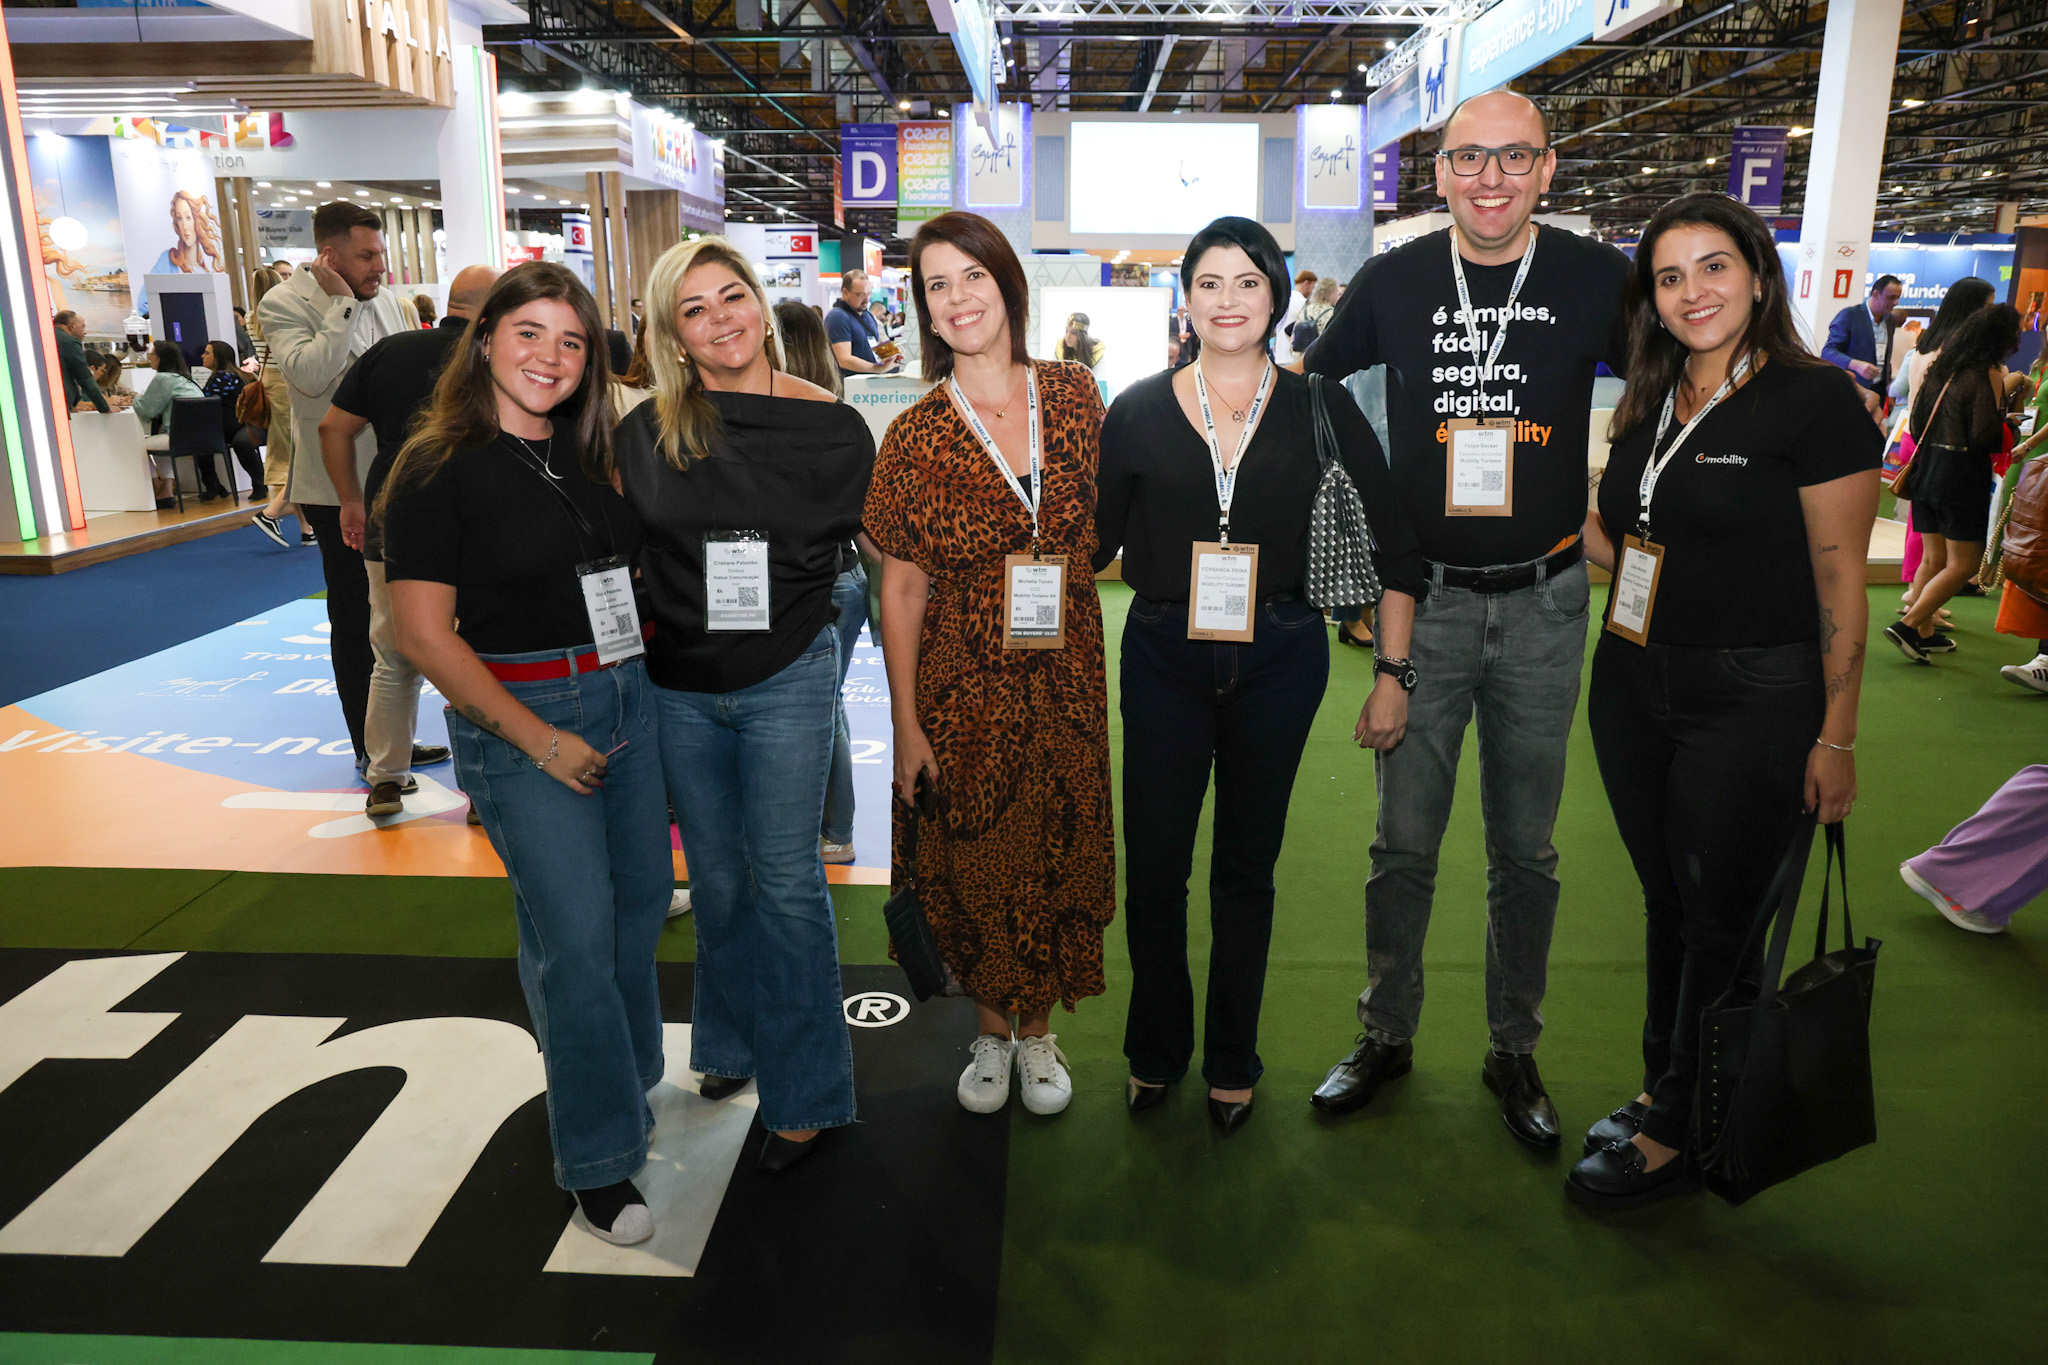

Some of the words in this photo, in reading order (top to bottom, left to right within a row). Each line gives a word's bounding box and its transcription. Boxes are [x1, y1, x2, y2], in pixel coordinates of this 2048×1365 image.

[346, 0, 451, 61] ITALIA
[1469, 10, 1535, 74] experience
[852, 151, 887, 198] D
[1741, 158, 1772, 204] F
[1432, 306, 1448, 325] é
[1453, 302, 1557, 324] smples,
[1432, 364, 1527, 387] segura,
[1433, 389, 1520, 417] digital,
[972, 418, 988, 442] ILHABELA
